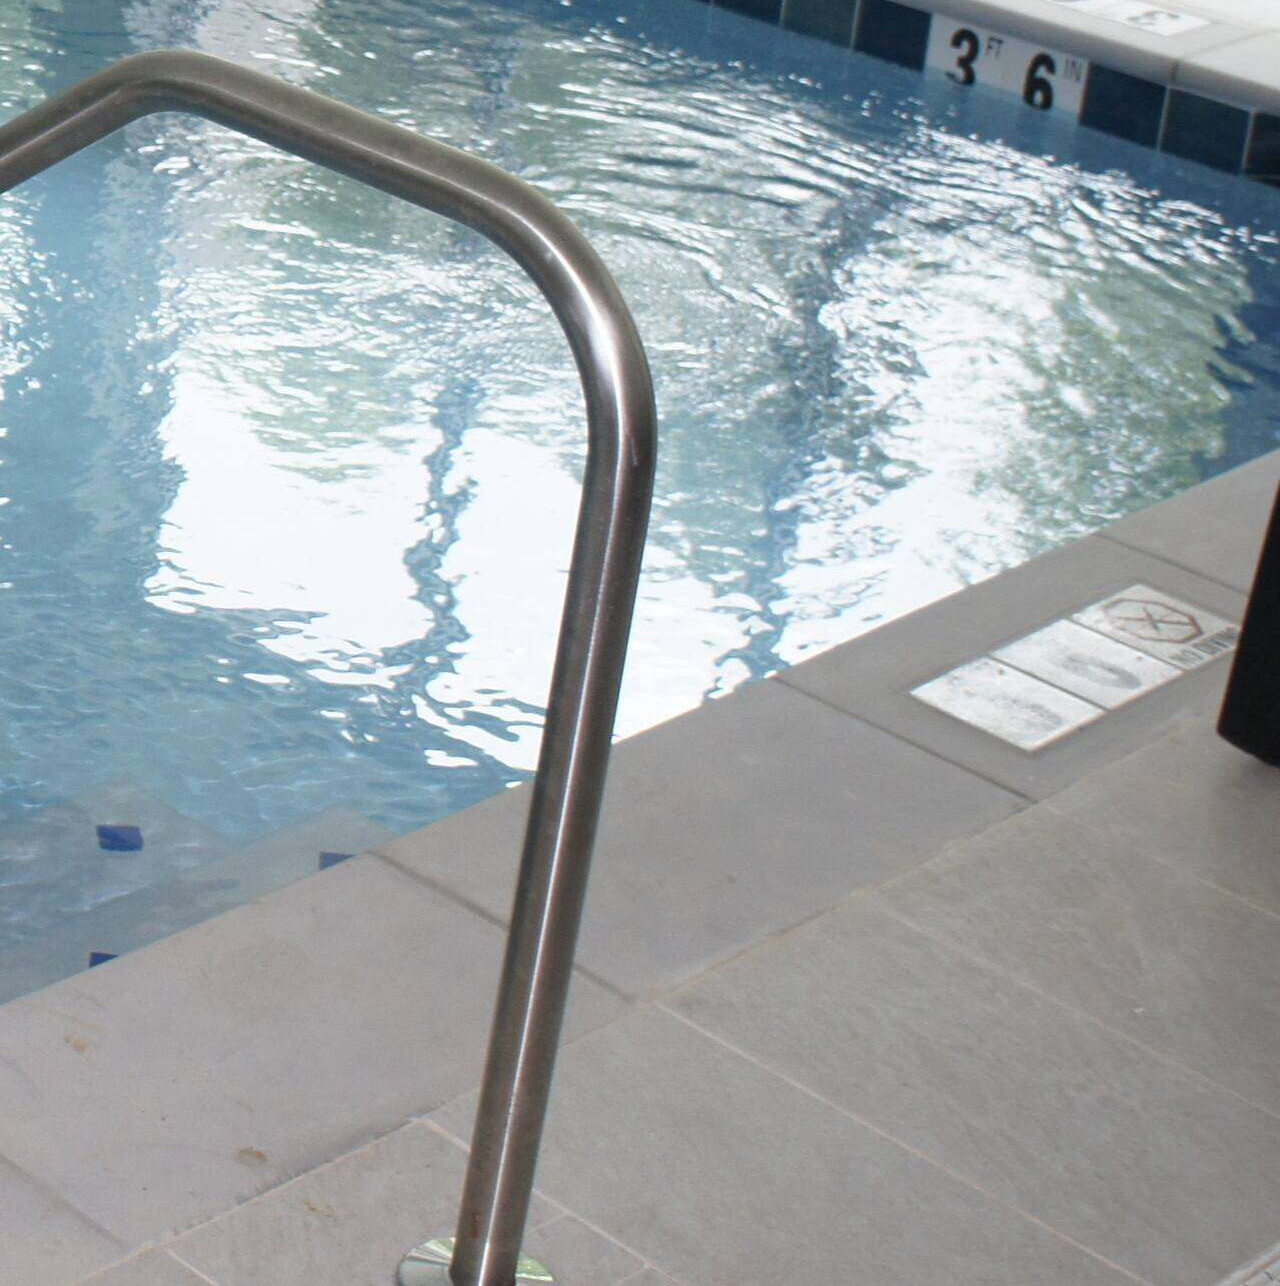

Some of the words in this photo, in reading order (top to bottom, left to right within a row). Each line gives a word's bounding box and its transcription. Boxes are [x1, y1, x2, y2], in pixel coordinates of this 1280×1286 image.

[946, 29, 979, 85] 3
[986, 37, 1004, 59] FT
[1024, 54, 1056, 111] 6
